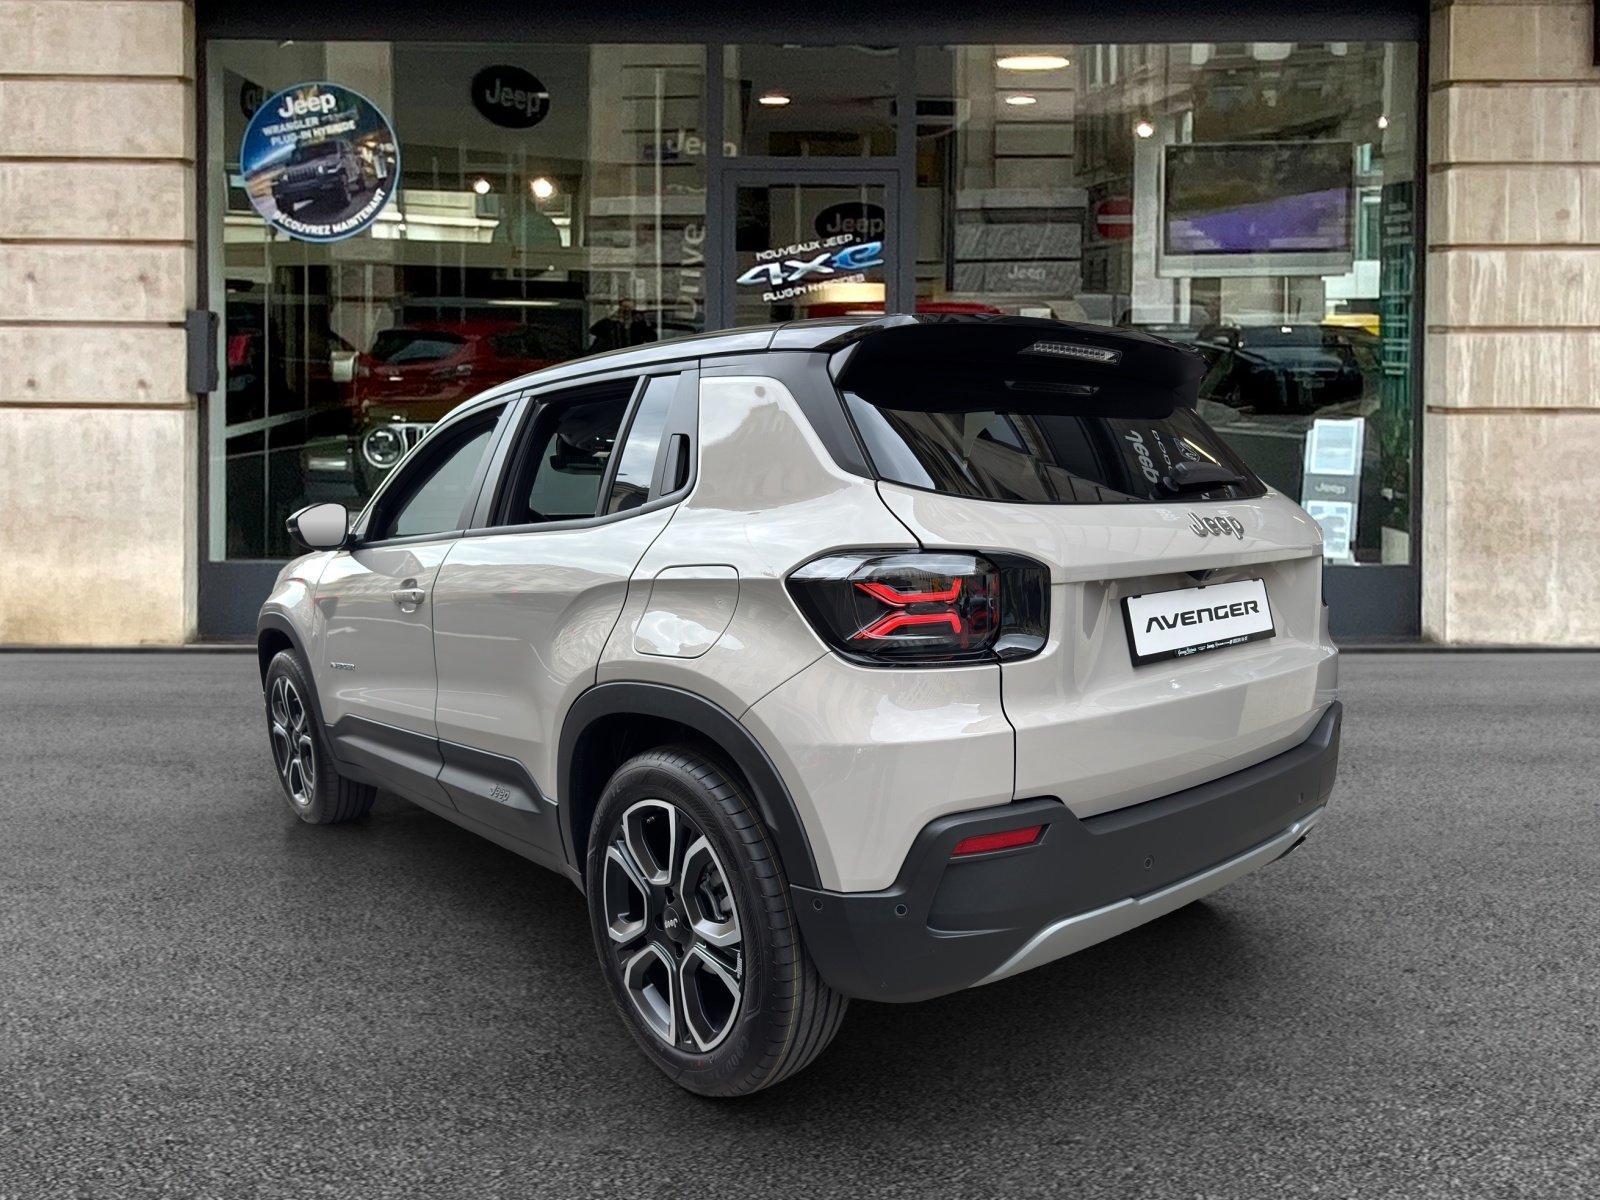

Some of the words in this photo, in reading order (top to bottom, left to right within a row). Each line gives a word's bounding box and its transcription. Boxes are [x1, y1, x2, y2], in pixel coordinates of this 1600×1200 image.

[277, 93, 337, 118] Jeep
[485, 78, 541, 117] Jeep
[262, 116, 320, 137] WRANGLER
[666, 130, 738, 157] Jep
[333, 188, 386, 234] MAINTENANT
[826, 211, 885, 236] Jeep
[756, 240, 820, 261] NOUVEAUX
[823, 234, 853, 247] JEEP
[1314, 482, 1346, 495] Jeep
[1187, 512, 1245, 540] Jeep
[1145, 600, 1260, 633] AVENGER
[489, 783, 510, 802] Jeep
